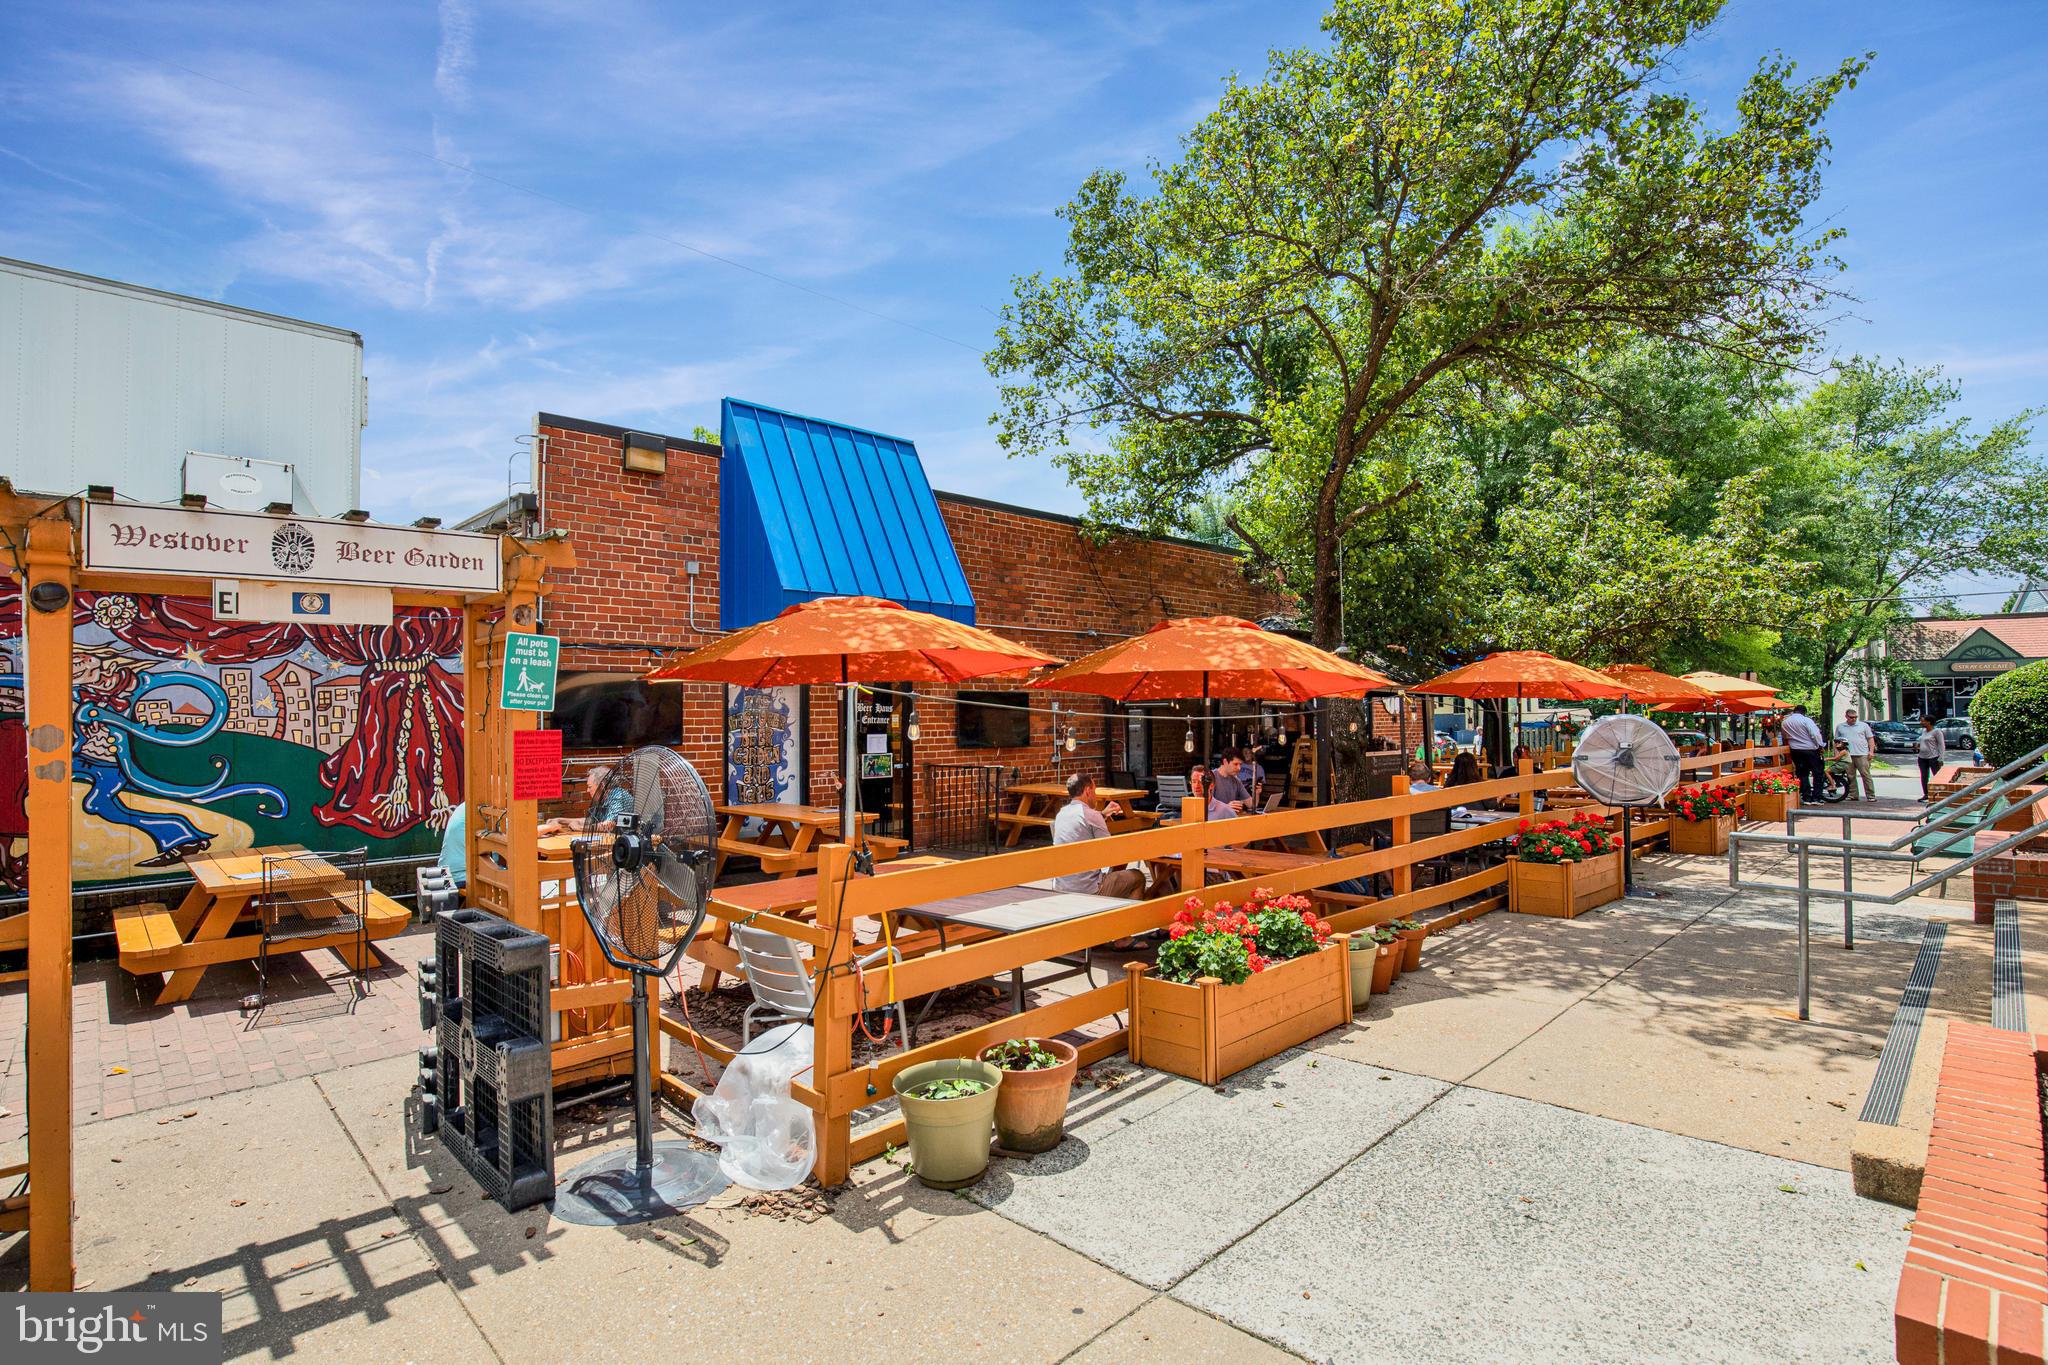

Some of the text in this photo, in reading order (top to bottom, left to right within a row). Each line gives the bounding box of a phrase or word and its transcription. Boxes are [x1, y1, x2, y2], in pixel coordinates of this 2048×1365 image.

[110, 523, 250, 554] Westover
[335, 541, 396, 564] Beer
[404, 547, 484, 571] Garden
[517, 637, 548, 649] All pets
[516, 648, 548, 657] must be
[530, 658, 552, 667] leash
[857, 703, 893, 713] Beer Haus
[862, 715, 890, 724] Entrance
